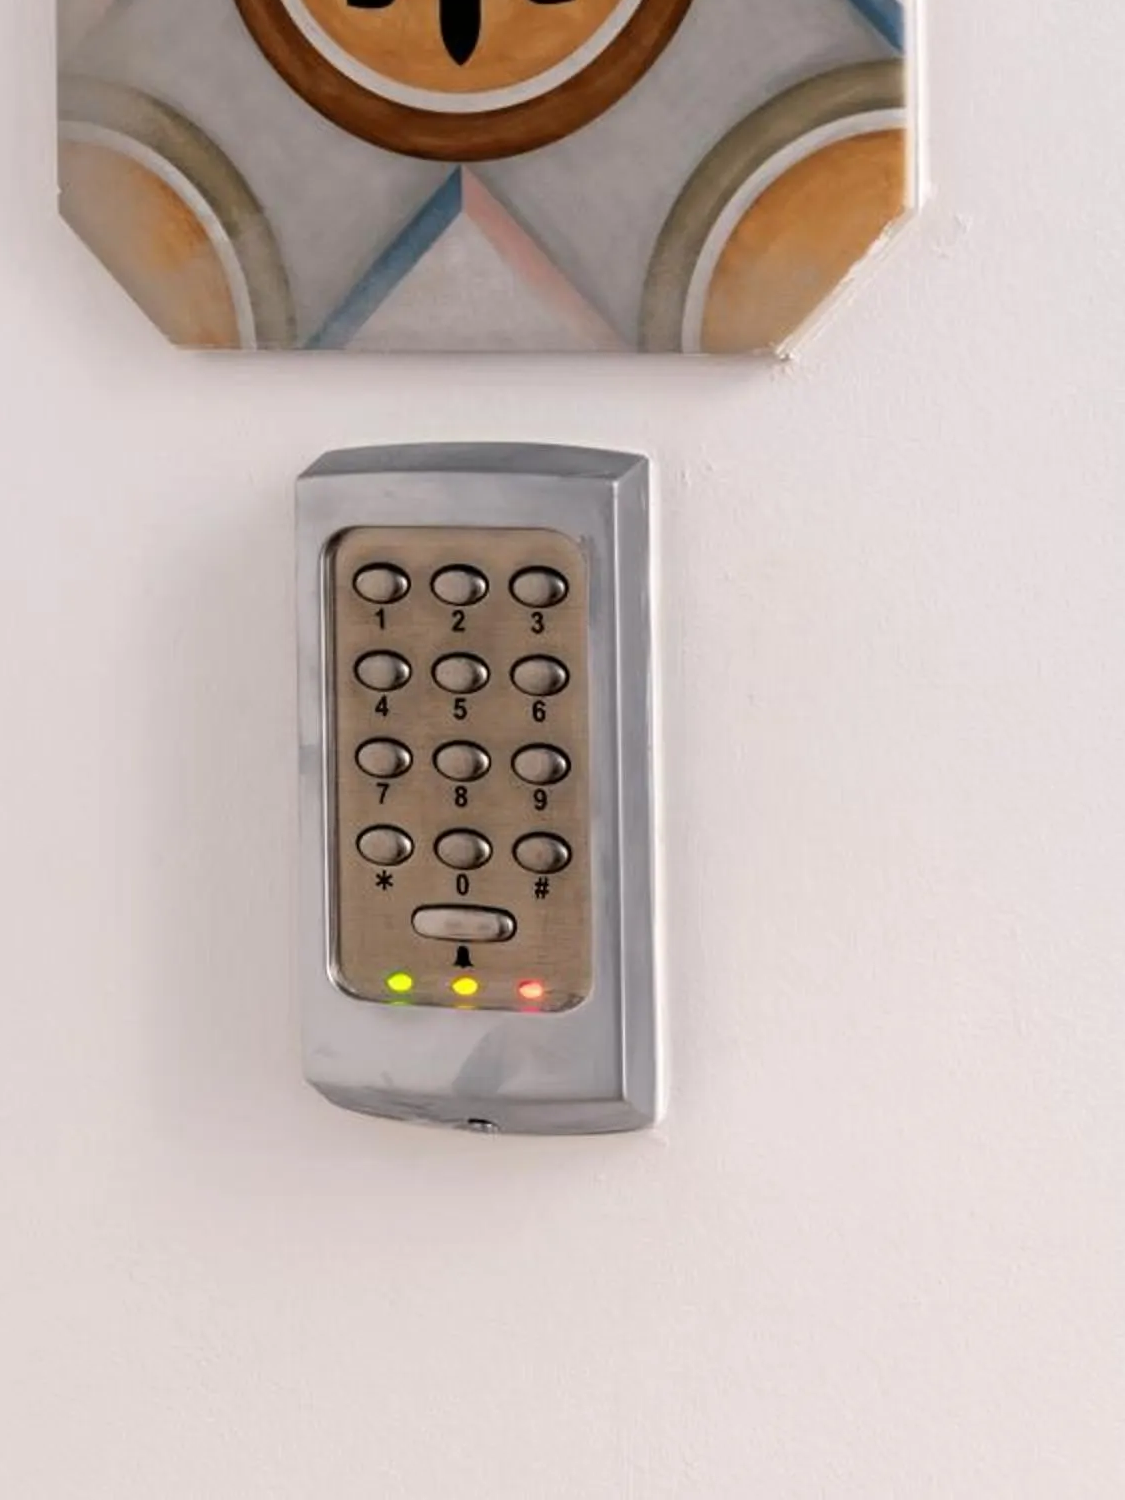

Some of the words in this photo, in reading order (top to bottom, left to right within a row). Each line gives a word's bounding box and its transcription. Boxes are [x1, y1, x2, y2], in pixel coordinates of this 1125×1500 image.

[374, 607, 385, 630] 1
[451, 609, 466, 633] 2
[530, 611, 545, 635] 3
[374, 694, 390, 717] 4
[453, 697, 468, 721] 5
[532, 699, 547, 723] 6
[376, 781, 391, 805] 7
[454, 785, 468, 808] 8
[532, 787, 548, 812] 9
[455, 873, 470, 897] 0
[534, 876, 550, 900] #
